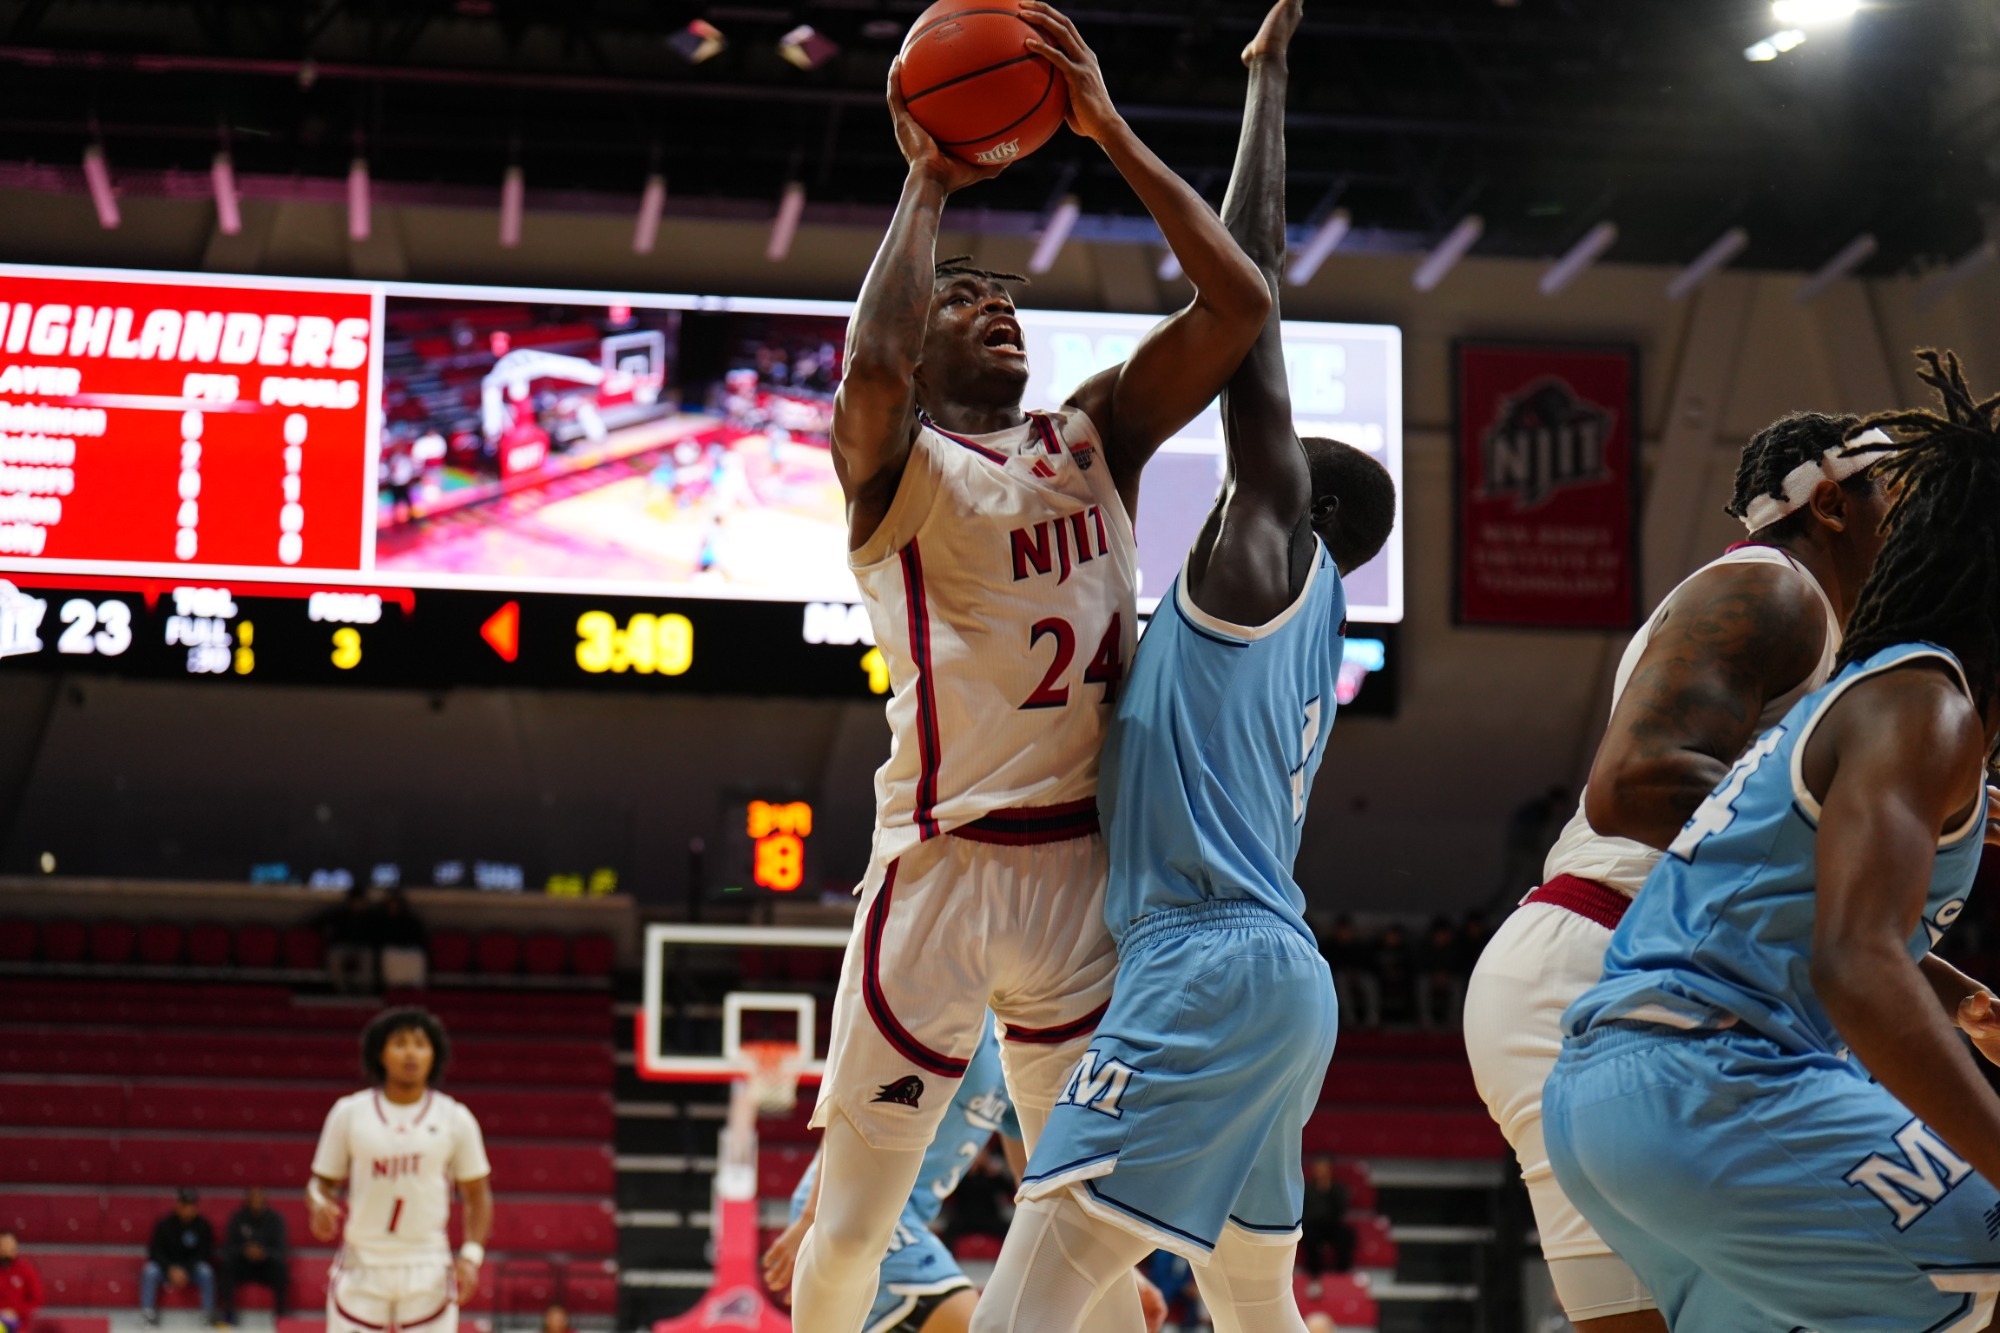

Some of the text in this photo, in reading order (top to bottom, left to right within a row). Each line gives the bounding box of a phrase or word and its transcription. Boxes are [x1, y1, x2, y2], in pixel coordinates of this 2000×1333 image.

[1009, 505, 1108, 586] NJIT
[57, 598, 132, 656] 23
[330, 627, 362, 670] 3
[1017, 611, 1122, 711] 24
[1055, 1049, 1144, 1121] M
[371, 1153, 424, 1183] NJIT
[1841, 1115, 1975, 1234] M
[387, 1196, 405, 1233] 1
